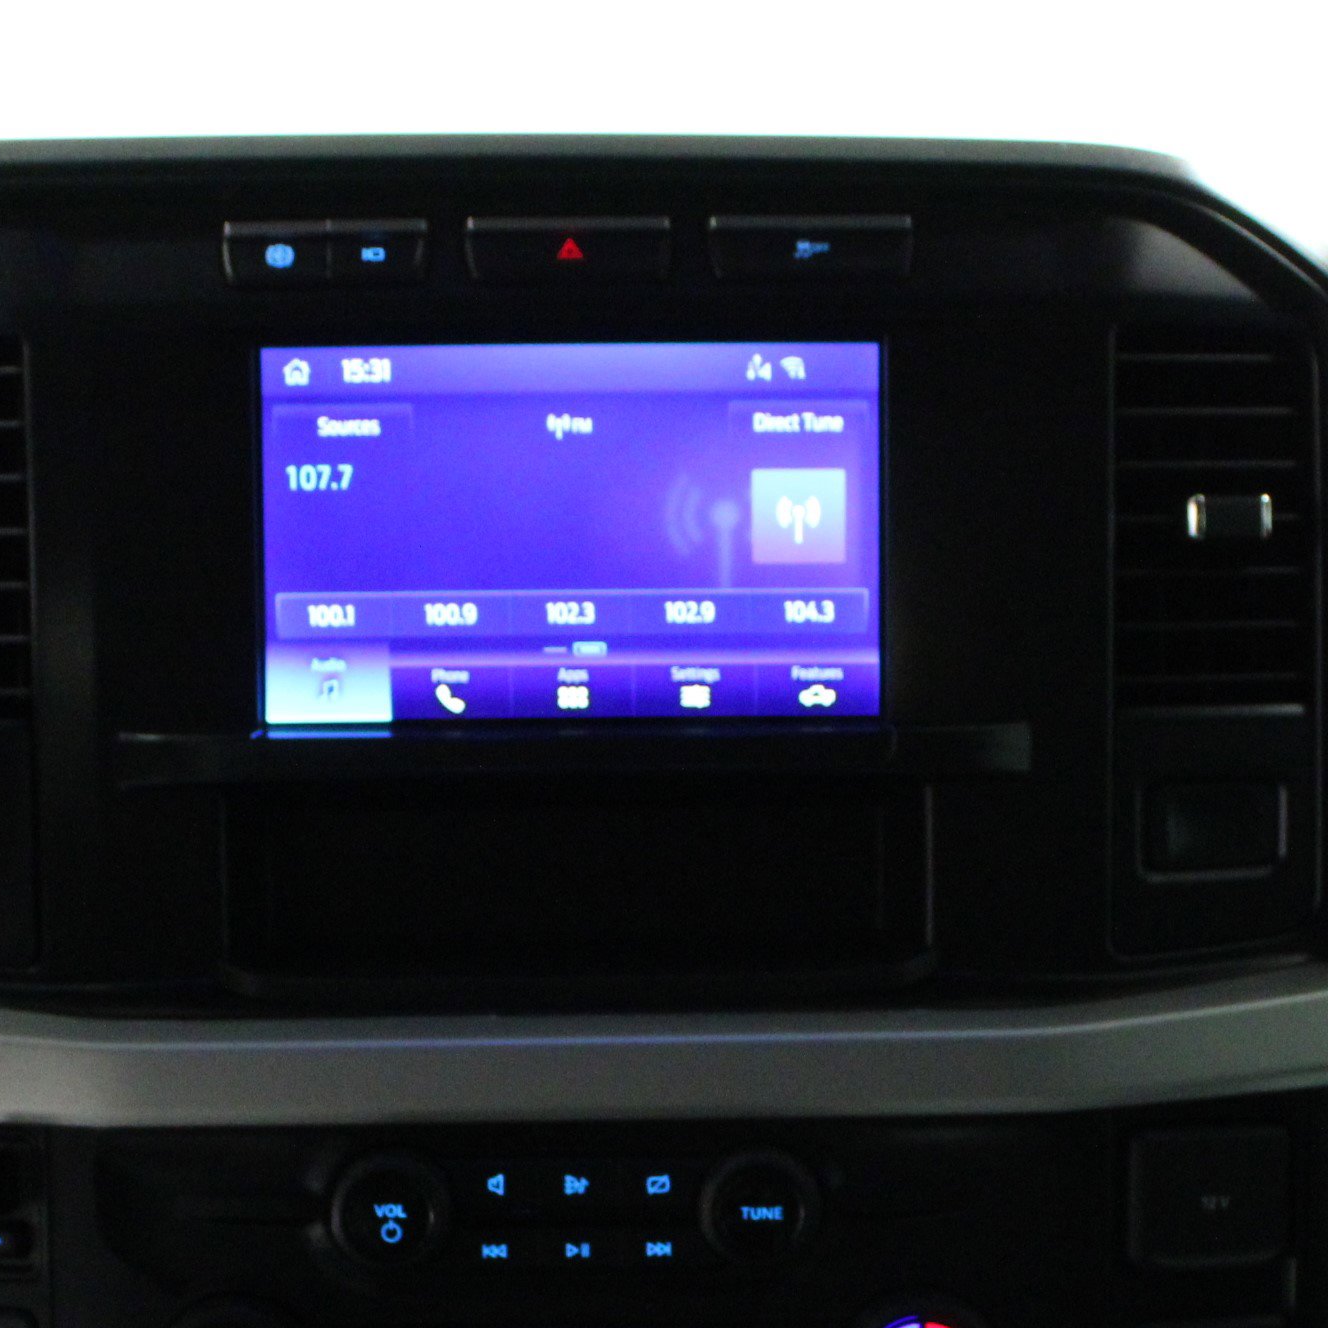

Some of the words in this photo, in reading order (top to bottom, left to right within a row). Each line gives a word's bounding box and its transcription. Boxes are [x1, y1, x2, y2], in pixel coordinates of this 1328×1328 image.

[341, 357, 392, 384] 15:31
[316, 415, 382, 437] Sources
[752, 411, 801, 433] Direct
[802, 411, 845, 433] Tune
[285, 464, 354, 491] 107.7
[307, 604, 356, 628] 100.1
[423, 602, 478, 627] 100.9
[545, 601, 596, 626] 102.3
[664, 600, 717, 625] 102.9
[783, 599, 836, 624] 104.3
[430, 668, 471, 685] Phone
[557, 667, 590, 684] Apps
[670, 665, 721, 684] Settings
[790, 664, 845, 682] Features
[374, 1203, 407, 1219] VOL
[741, 1206, 784, 1221] TUNE
